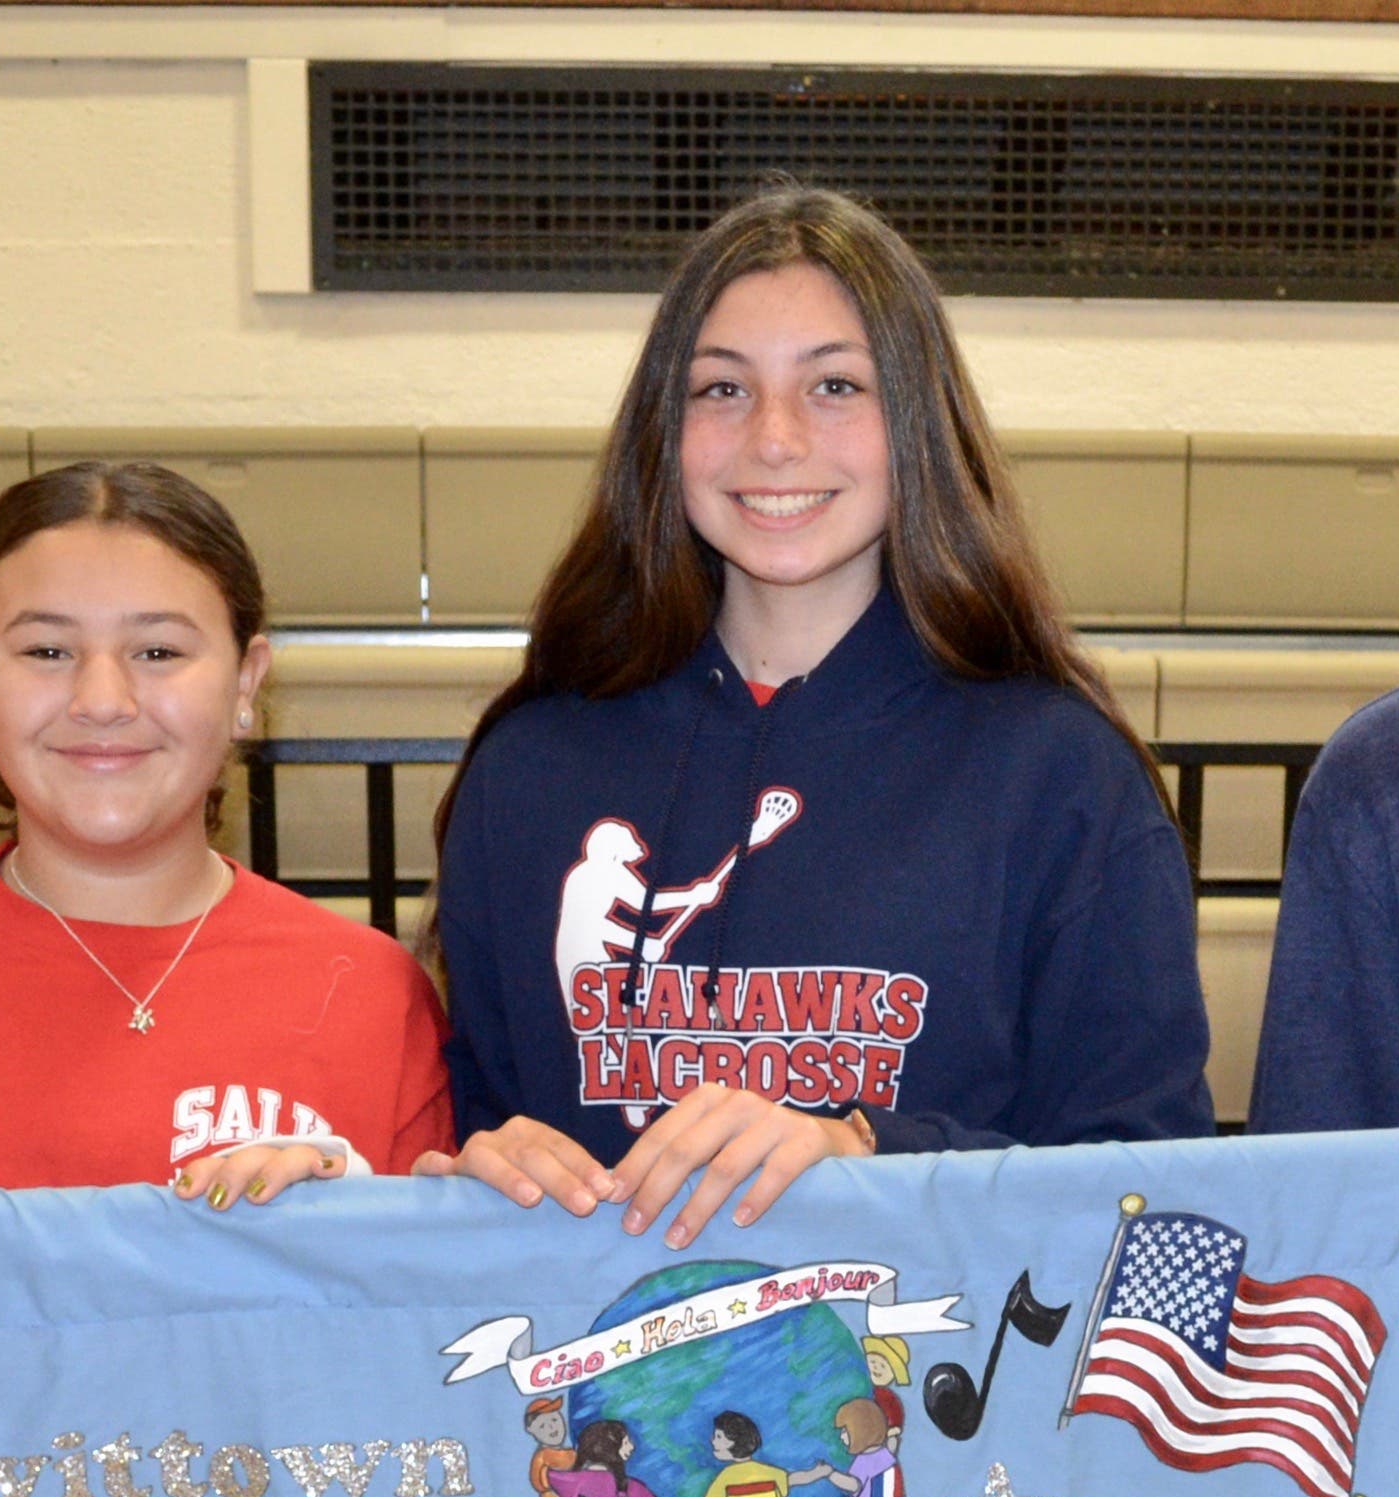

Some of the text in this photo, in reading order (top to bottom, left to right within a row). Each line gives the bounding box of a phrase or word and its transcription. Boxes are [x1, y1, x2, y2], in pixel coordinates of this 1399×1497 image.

[571, 963, 929, 1043] SEAHAWKS
[578, 1033, 905, 1111] LACROSSE
[530, 1266, 880, 1389] Ciao Hola Bonjour
